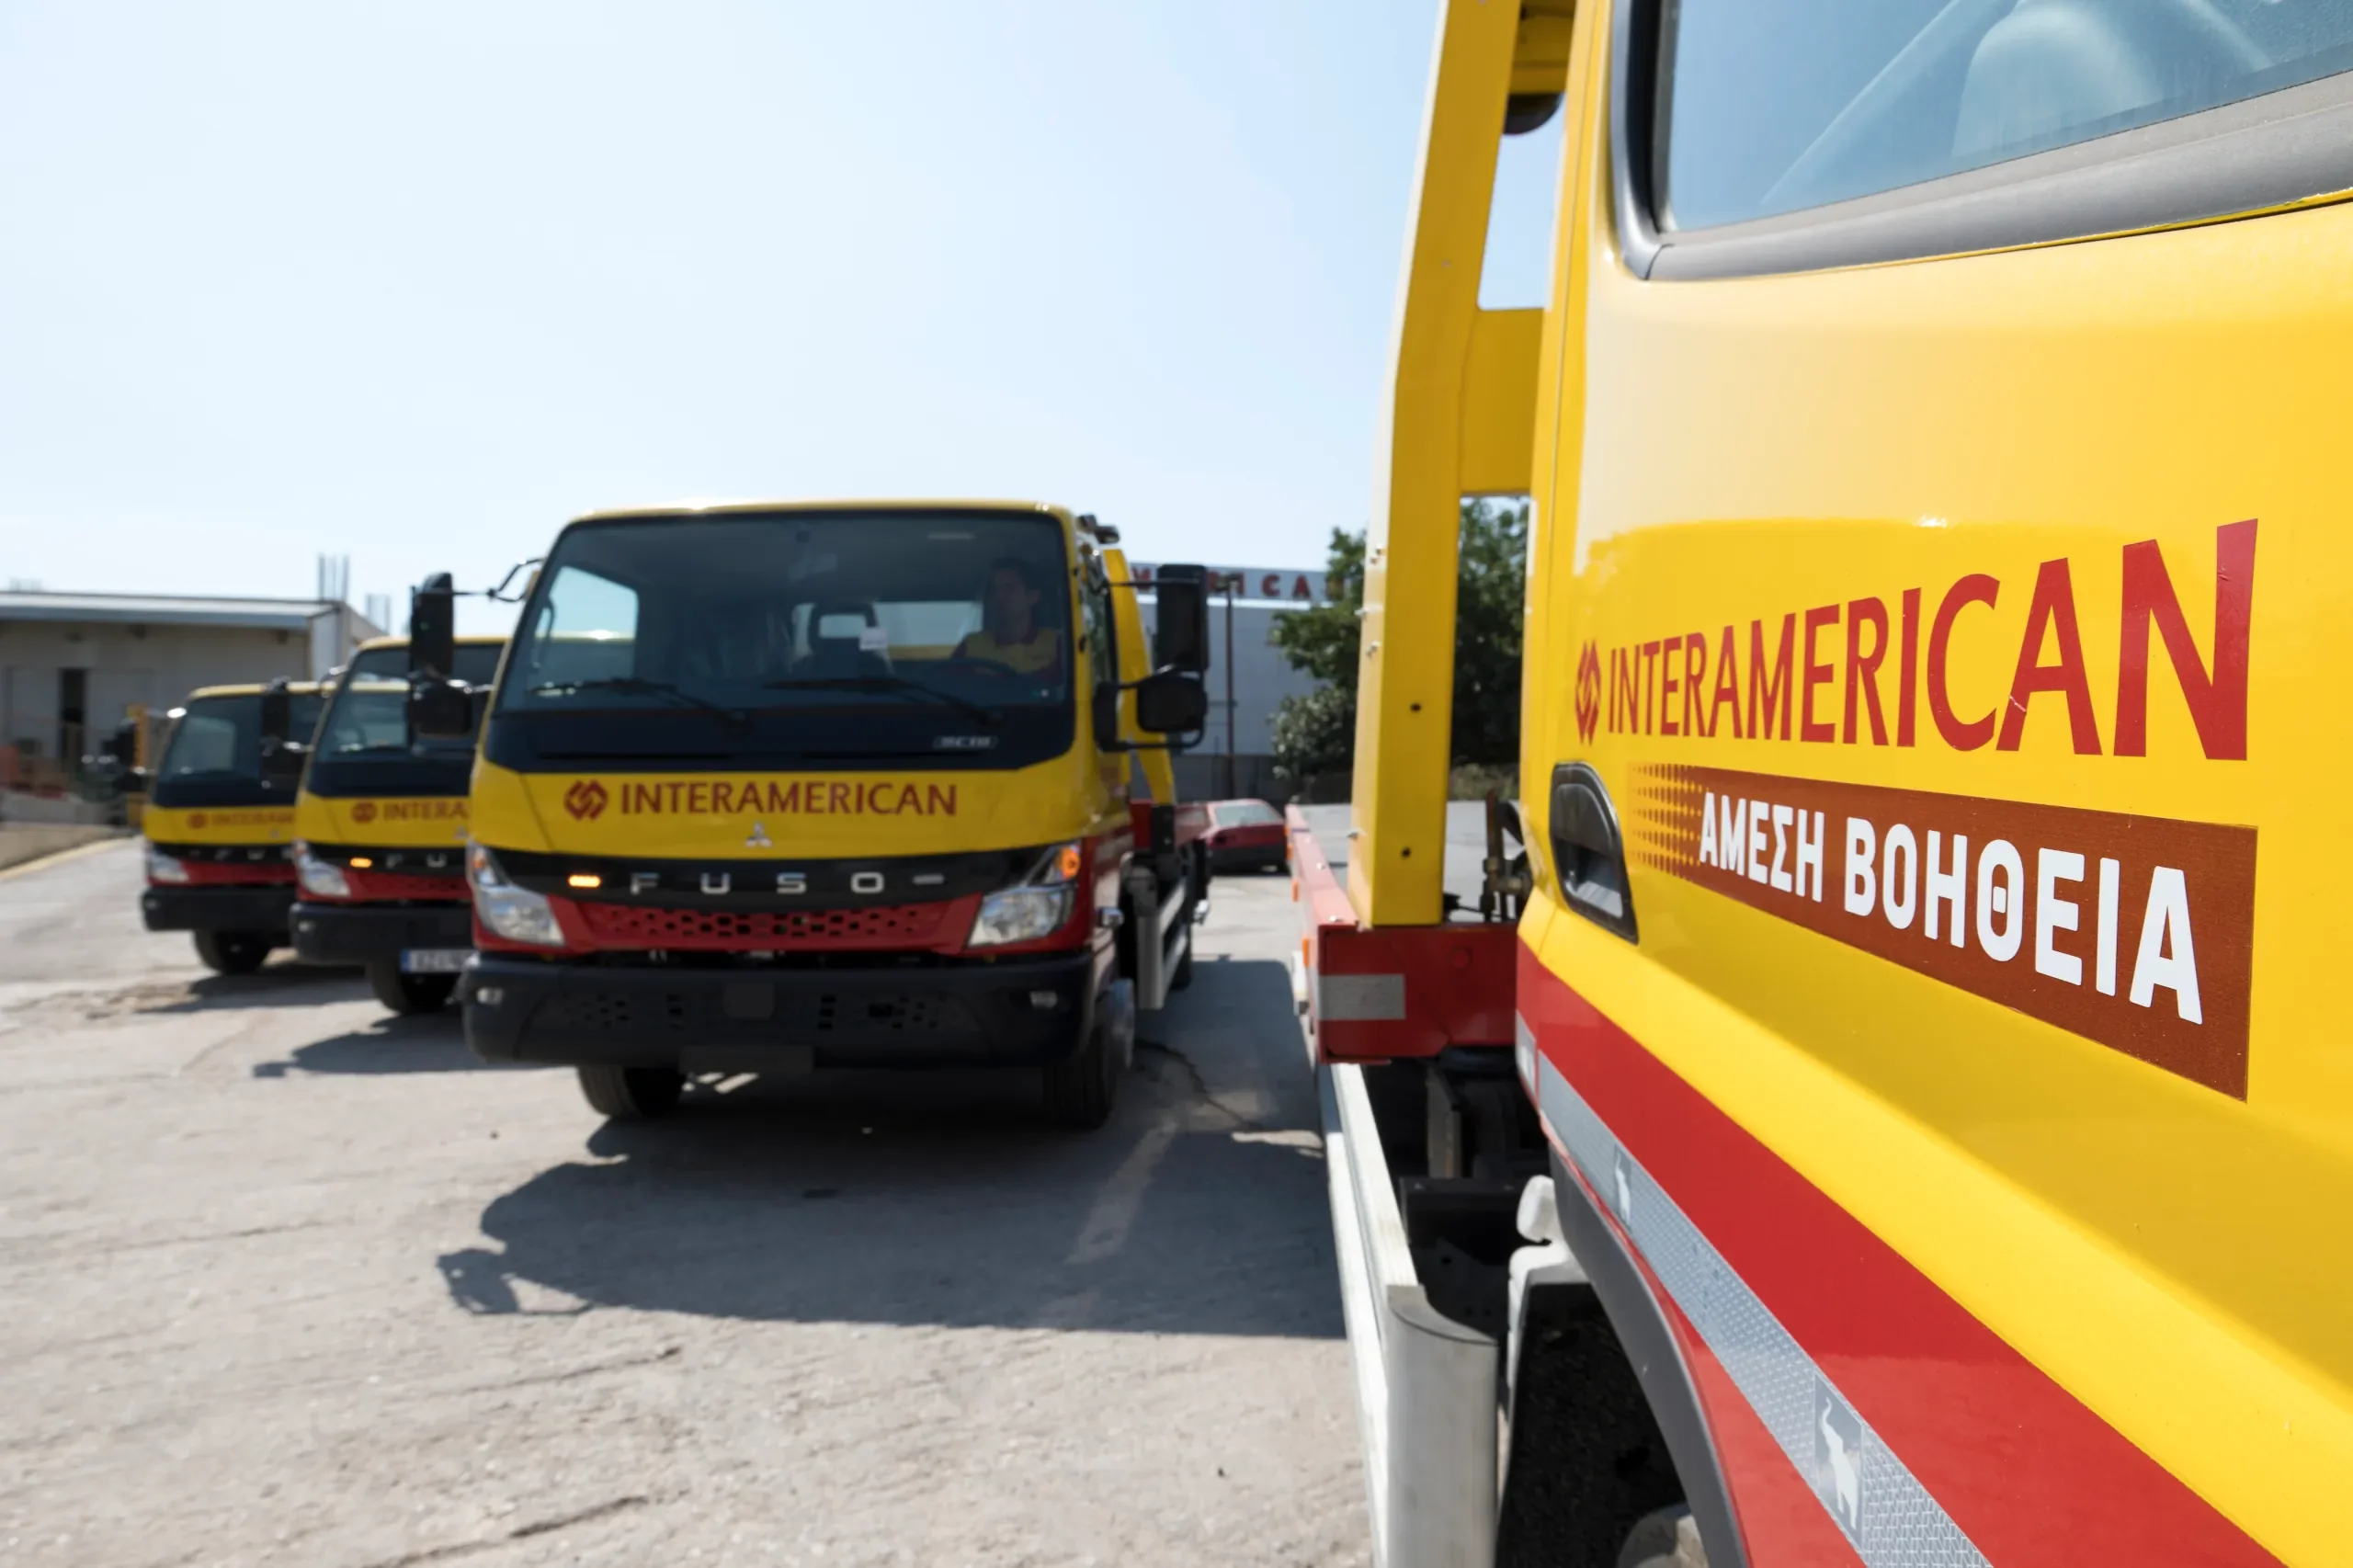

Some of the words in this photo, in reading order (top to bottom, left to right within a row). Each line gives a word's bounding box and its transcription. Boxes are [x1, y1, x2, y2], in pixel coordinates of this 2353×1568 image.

[1608, 518, 2259, 761] INTERAMERICAN
[382, 800, 471, 822] INTERA
[620, 780, 958, 816] INTERAMERICAN
[385, 852, 448, 869] FU
[630, 871, 885, 895] FUSO
[1698, 791, 1825, 903] ΑΜΕΣΗ
[1844, 815, 2204, 1026] ΒΟΗΘΕΙΑ
